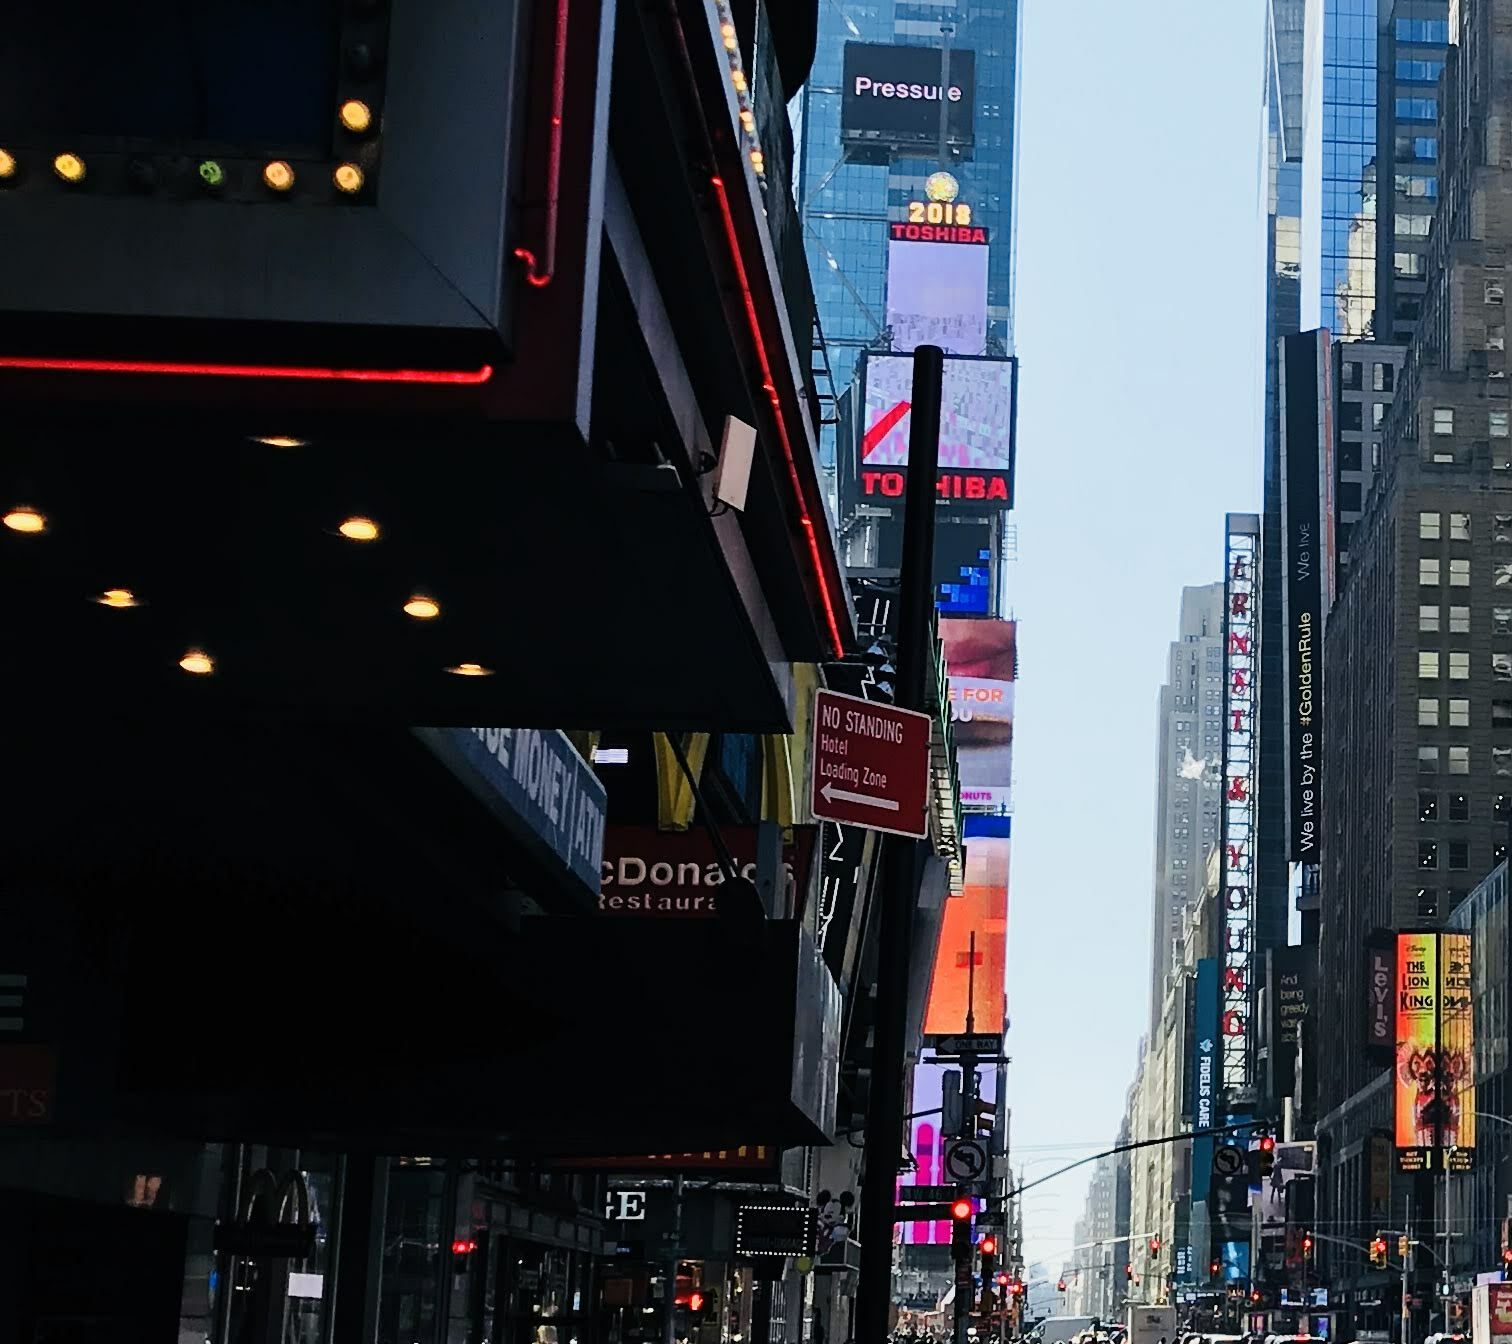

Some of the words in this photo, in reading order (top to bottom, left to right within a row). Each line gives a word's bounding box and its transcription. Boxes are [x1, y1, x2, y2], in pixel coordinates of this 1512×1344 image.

[908, 202, 972, 225] 2018
[891, 224, 986, 244] TOSHIBA
[862, 470, 1008, 501] TOHIBA
[1297, 550, 1311, 581] We
[1298, 611, 1313, 726] #GoldenRule
[963, 688, 1004, 703] FOR
[822, 705, 840, 730] NO
[845, 711, 904, 744] STANDING
[821, 734, 848, 755] Hotel
[1300, 732, 1313, 761] the
[513, 728, 573, 833] MONEY
[820, 757, 859, 788] Loading
[862, 767, 887, 788] Zone
[1300, 764, 1316, 786] by
[959, 791, 993, 802] ONUTS
[1300, 789, 1314, 817] live
[1299, 818, 1314, 852] We
[1406, 961, 1426, 971] THE
[1402, 973, 1430, 991] LION
[1400, 991, 1433, 1012] KING
[1198, 1056, 1212, 1097] FIDELIS
[1197, 1098, 1211, 1128] CARE
